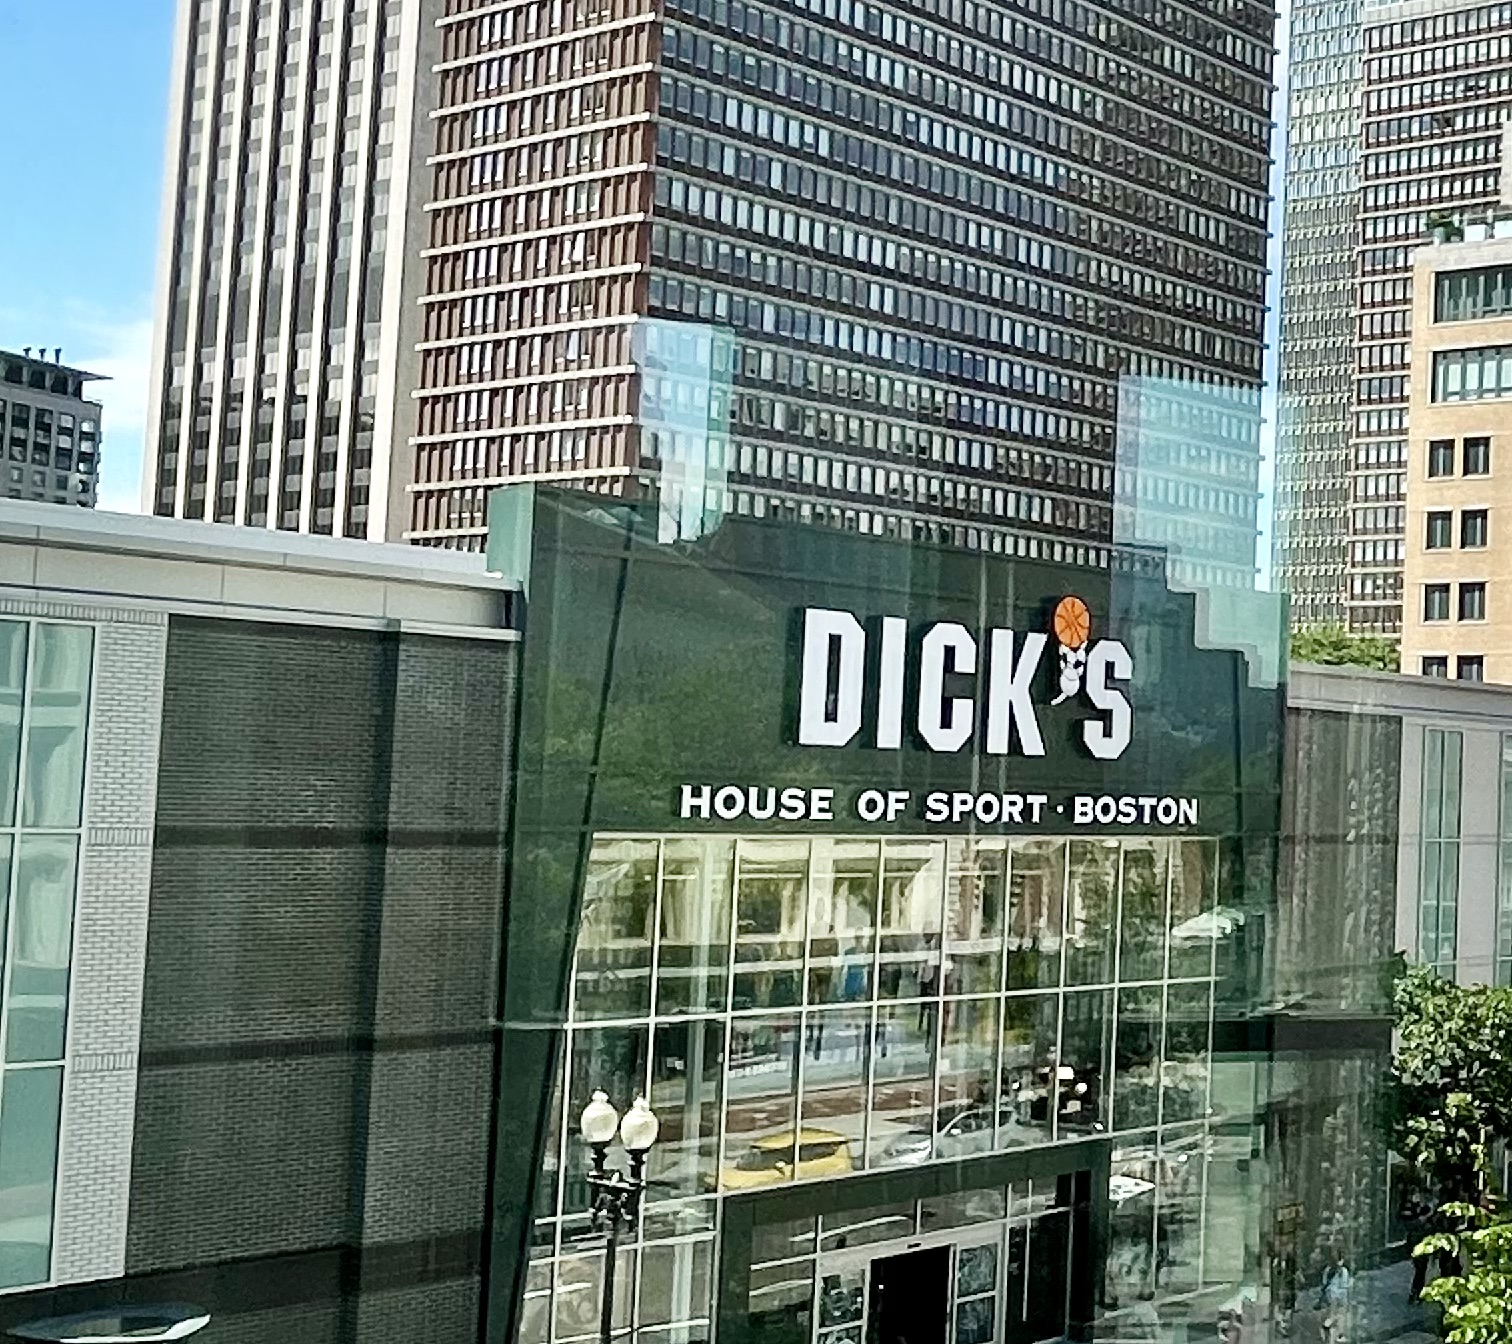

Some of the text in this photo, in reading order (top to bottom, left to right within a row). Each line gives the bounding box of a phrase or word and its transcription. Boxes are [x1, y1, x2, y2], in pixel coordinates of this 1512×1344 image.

[798, 596, 1134, 761] DICK'S
[680, 784, 1198, 825] HOUSE OF SPORT BOSTON
